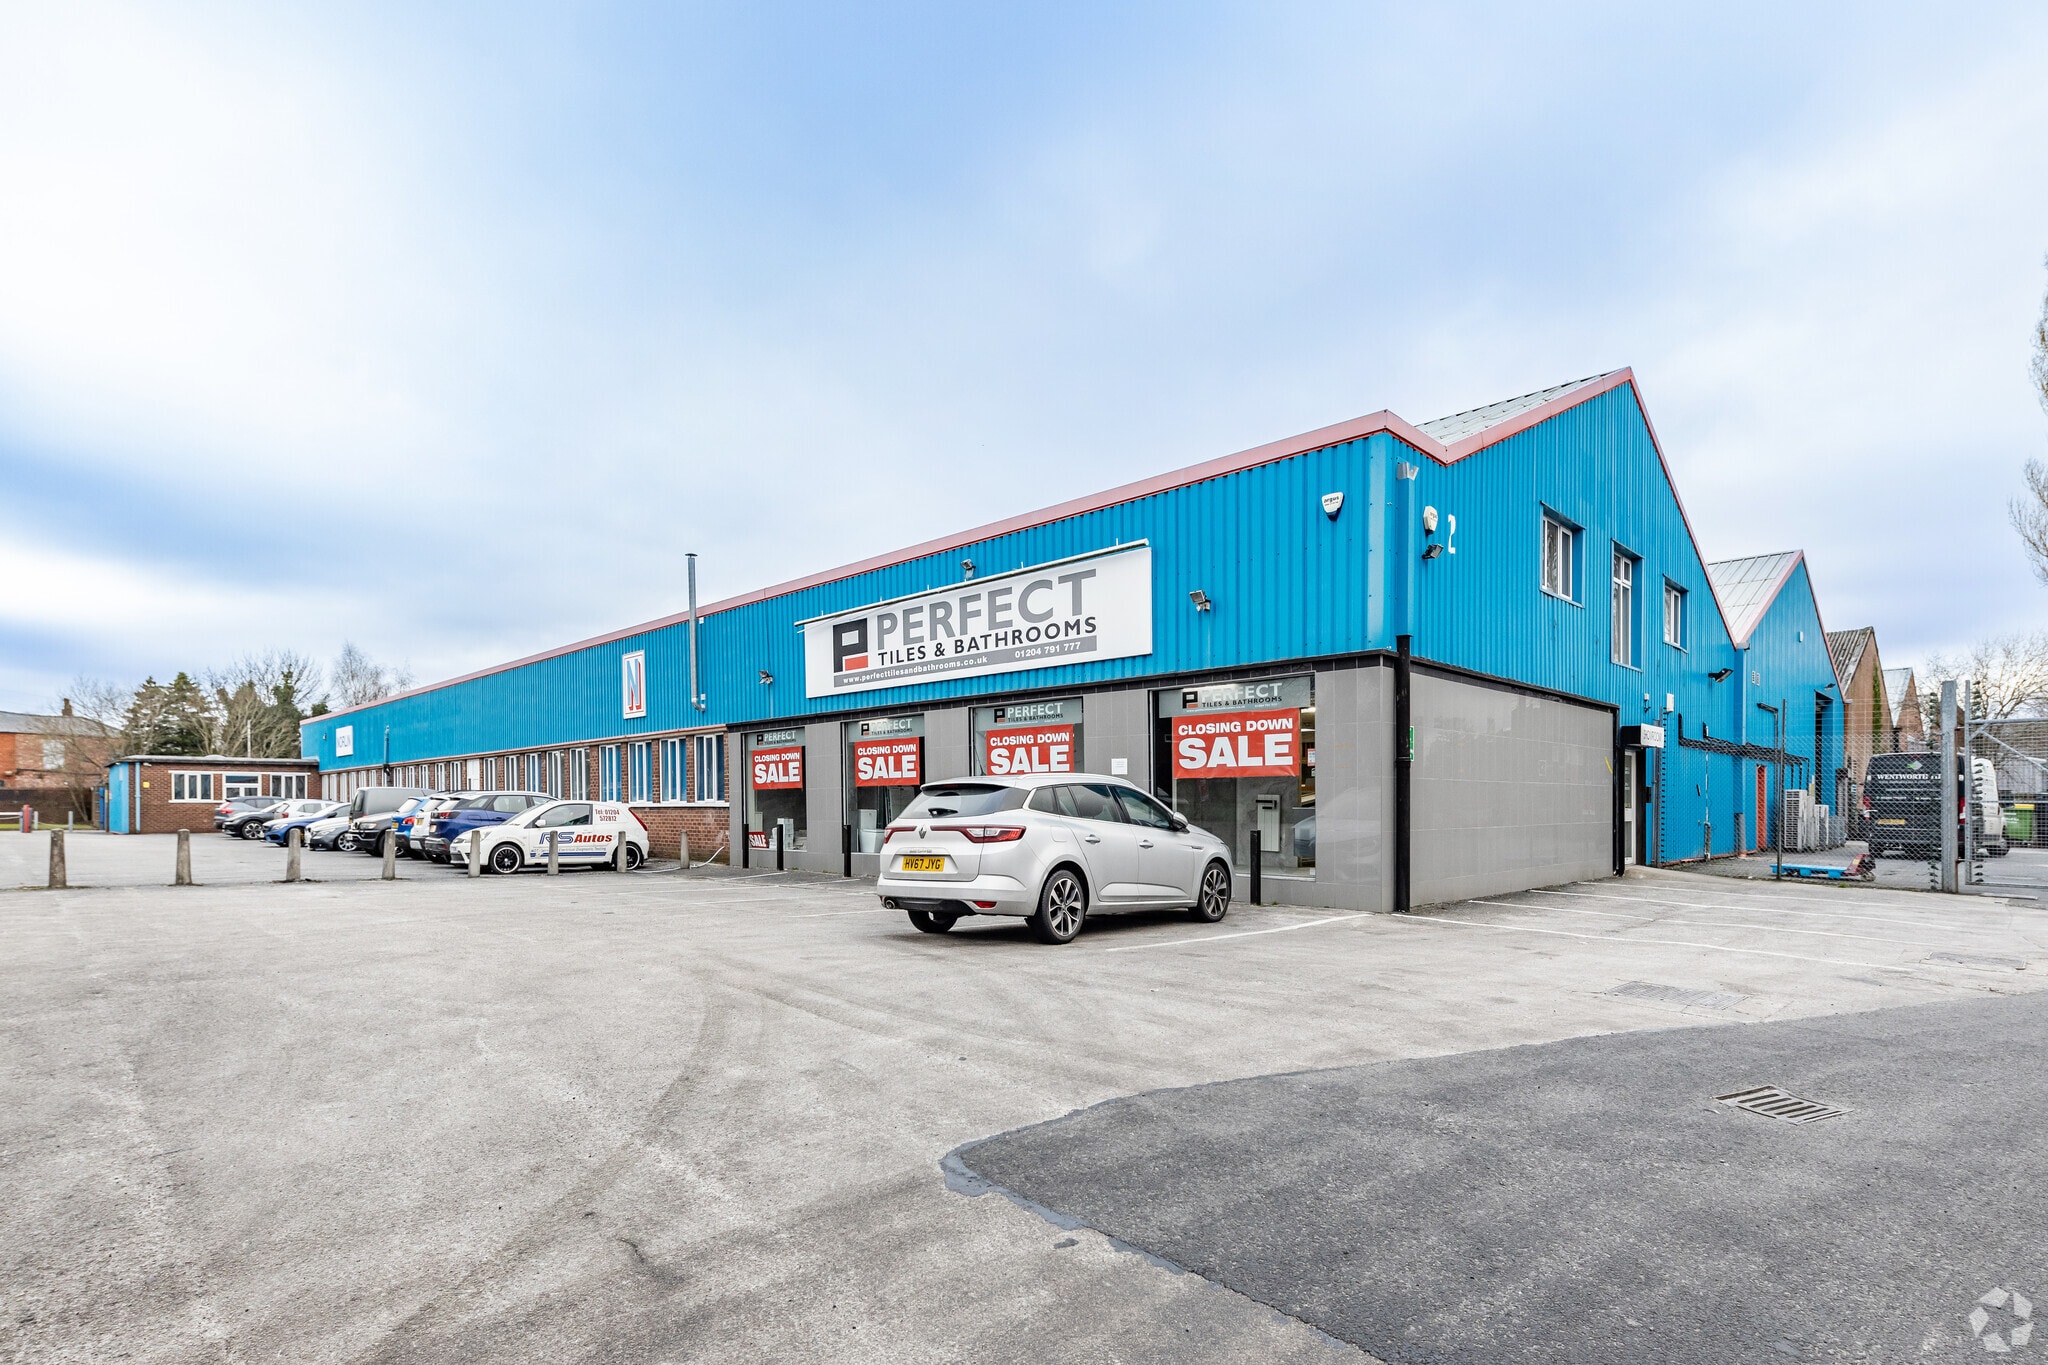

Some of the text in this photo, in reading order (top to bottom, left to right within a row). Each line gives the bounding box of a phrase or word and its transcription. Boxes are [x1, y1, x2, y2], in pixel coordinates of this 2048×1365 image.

[1448, 514, 1456, 554] 2
[877, 569, 1097, 650] PERFECT
[878, 617, 1097, 666] TILES & BATHROOMS
[1015, 642, 1081, 659] 01204 791 777
[843, 656, 988, 684] www.perfecttilesandbathrooms.co.uk
[1202, 683, 1282, 703] PERFECT
[1233, 696, 1282, 706] BATHROOMS
[1007, 702, 1063, 718] PERFECT
[1029, 713, 1063, 721] BATHROOMS
[1178, 717, 1293, 736] CLOSING DOWN
[764, 730, 796, 742] PERFECT
[990, 732, 1070, 747] CLOSING DOWN
[754, 752, 800, 763] CLOSING DOWN
[857, 744, 916, 756] CLOSING DOWN
[1178, 733, 1293, 770] SALE
[858, 755, 917, 780] SALE
[990, 745, 1070, 775] SALE
[754, 761, 800, 785] SALE
[574, 834, 613, 843] Autos
[749, 834, 766, 847] SALE
[905, 858, 941, 870] HV67 JYG
